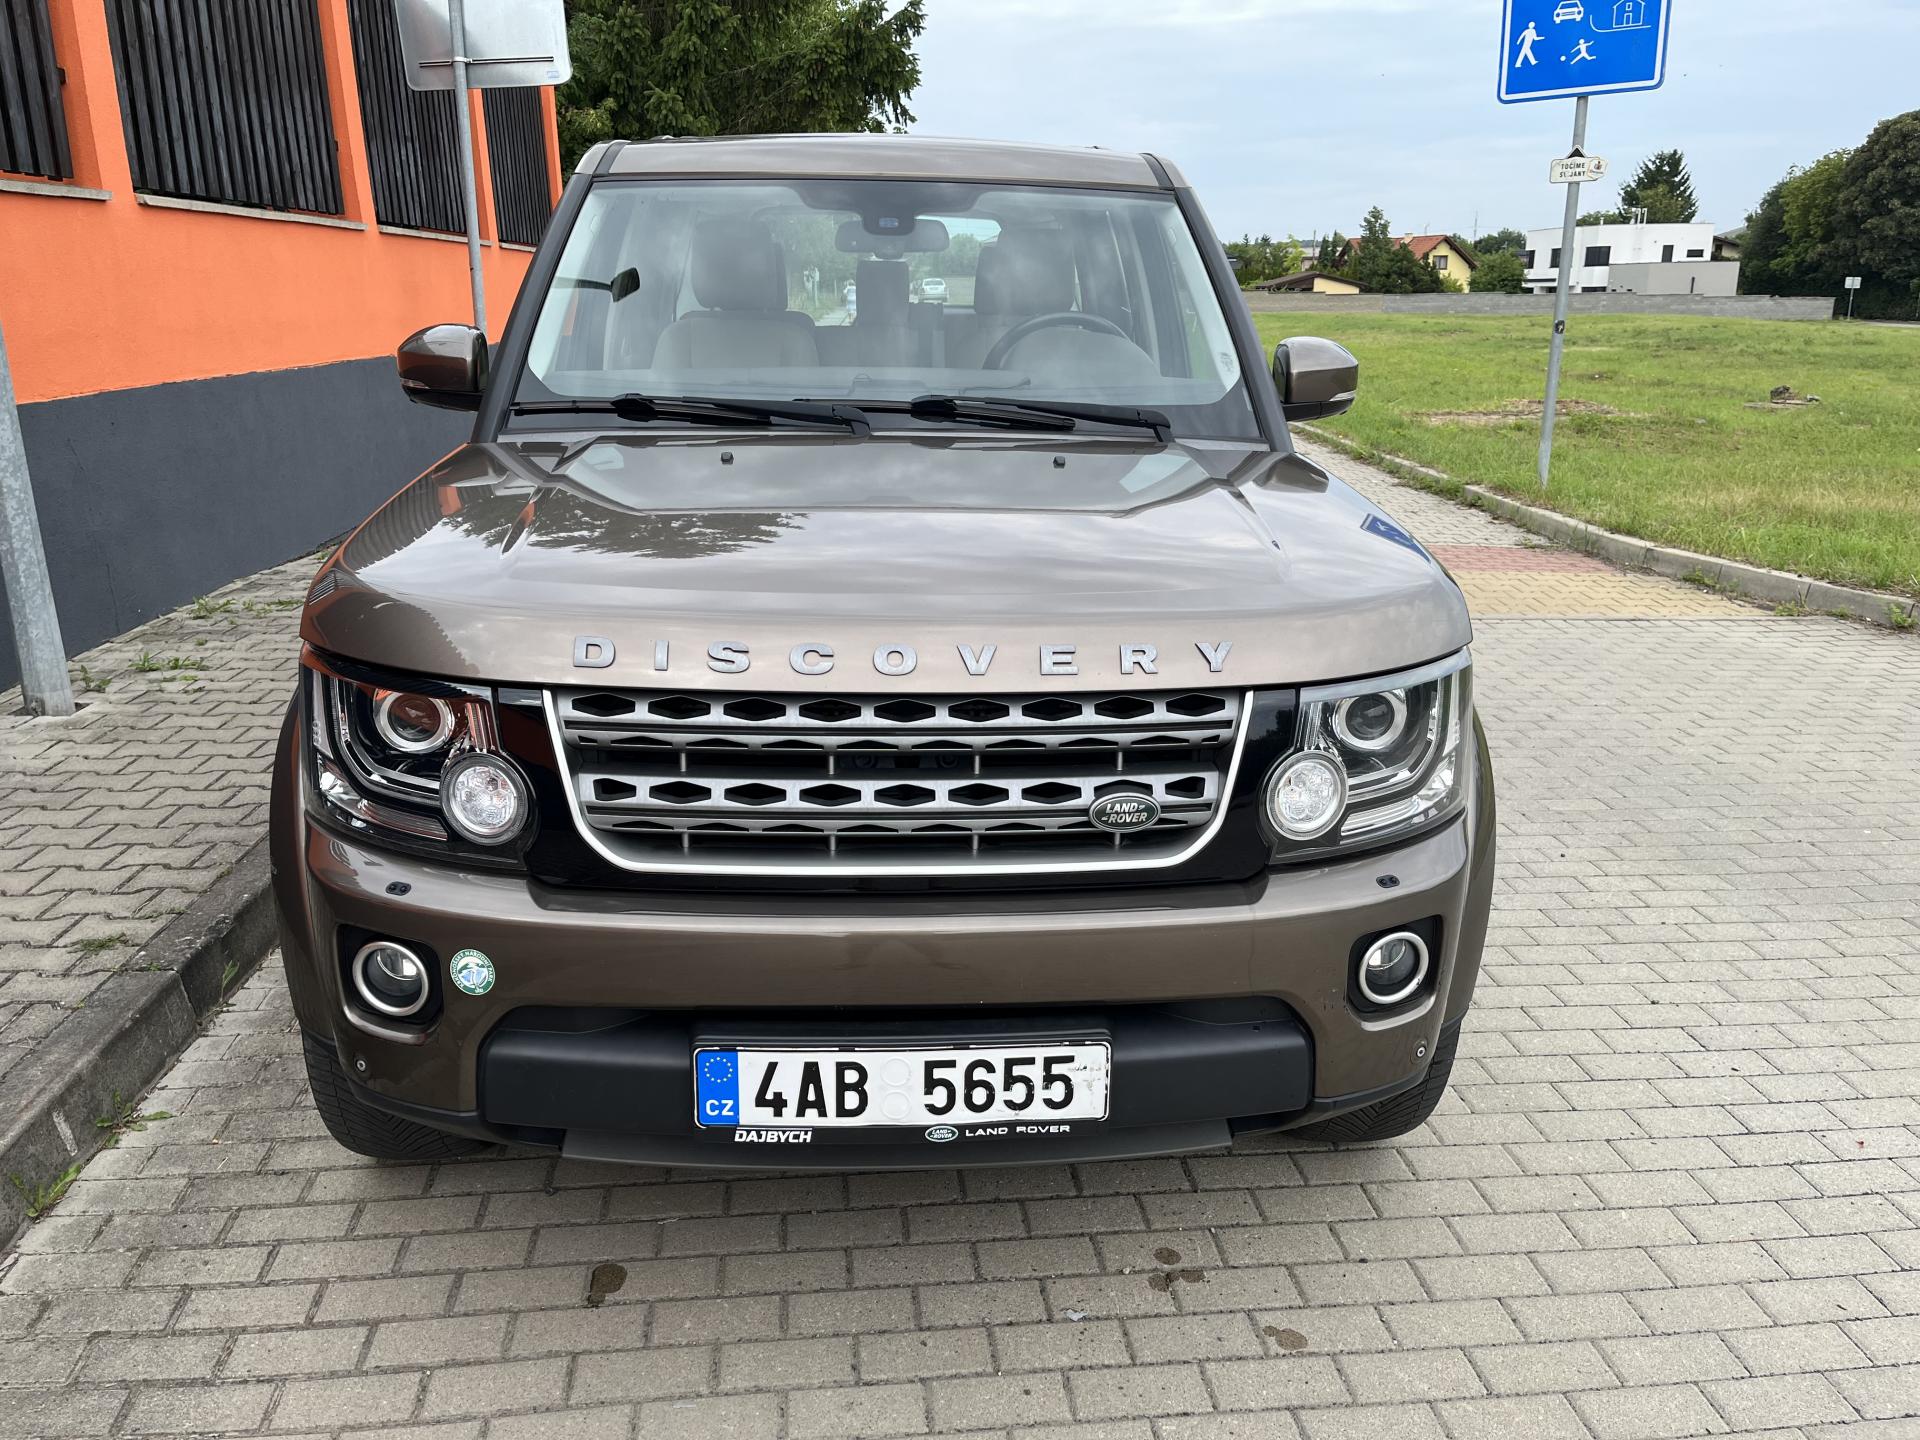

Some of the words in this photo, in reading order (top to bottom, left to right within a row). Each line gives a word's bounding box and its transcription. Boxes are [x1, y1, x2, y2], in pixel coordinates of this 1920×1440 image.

[1559, 170, 1586, 178] SJANY
[572, 635, 1234, 675] DISCOVERY
[1105, 802, 1138, 814] LAND
[1107, 812, 1147, 823] ROVER
[754, 1060, 870, 1119] 4AB
[923, 1054, 1077, 1117] 5655
[706, 1099, 735, 1117] CZ
[734, 1130, 812, 1143] DAJBYCH
[965, 1126, 1009, 1137] LAND
[1016, 1123, 1071, 1134] ROVER
